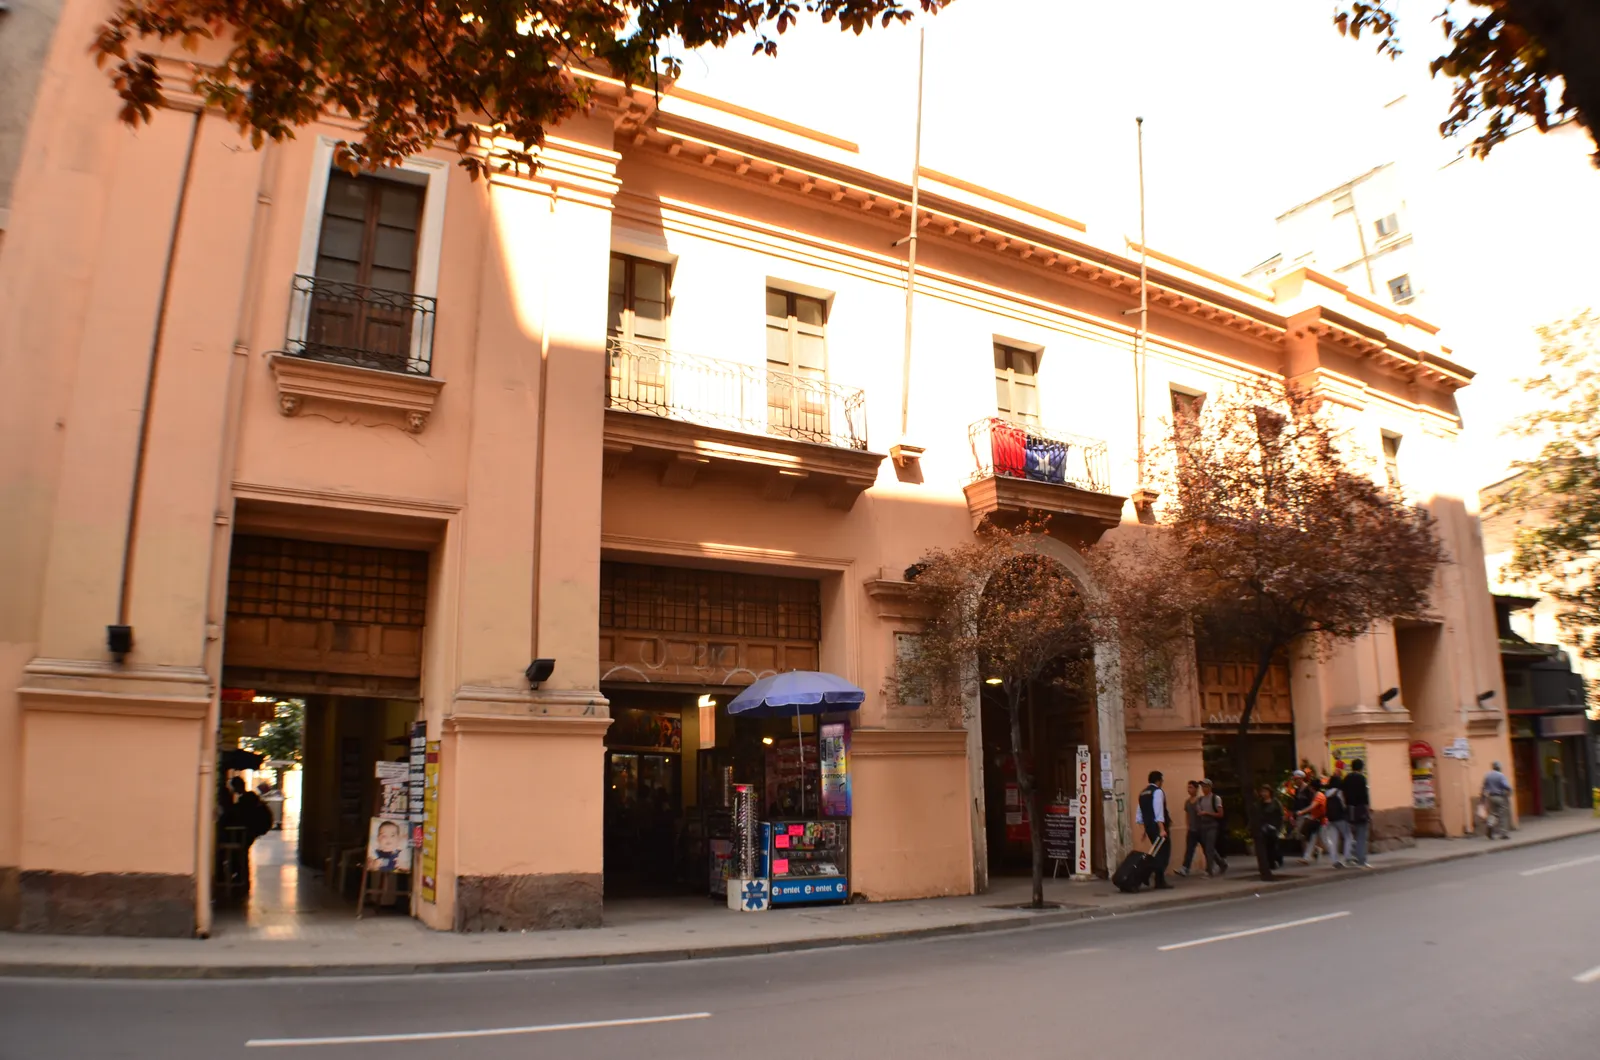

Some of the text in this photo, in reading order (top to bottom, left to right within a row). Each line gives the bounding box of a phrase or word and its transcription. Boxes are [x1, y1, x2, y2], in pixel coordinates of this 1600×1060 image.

[1079, 762, 1088, 871] FOTOCOPIAS
[783, 886, 800, 895] entel
[815, 885, 832, 893] entel
